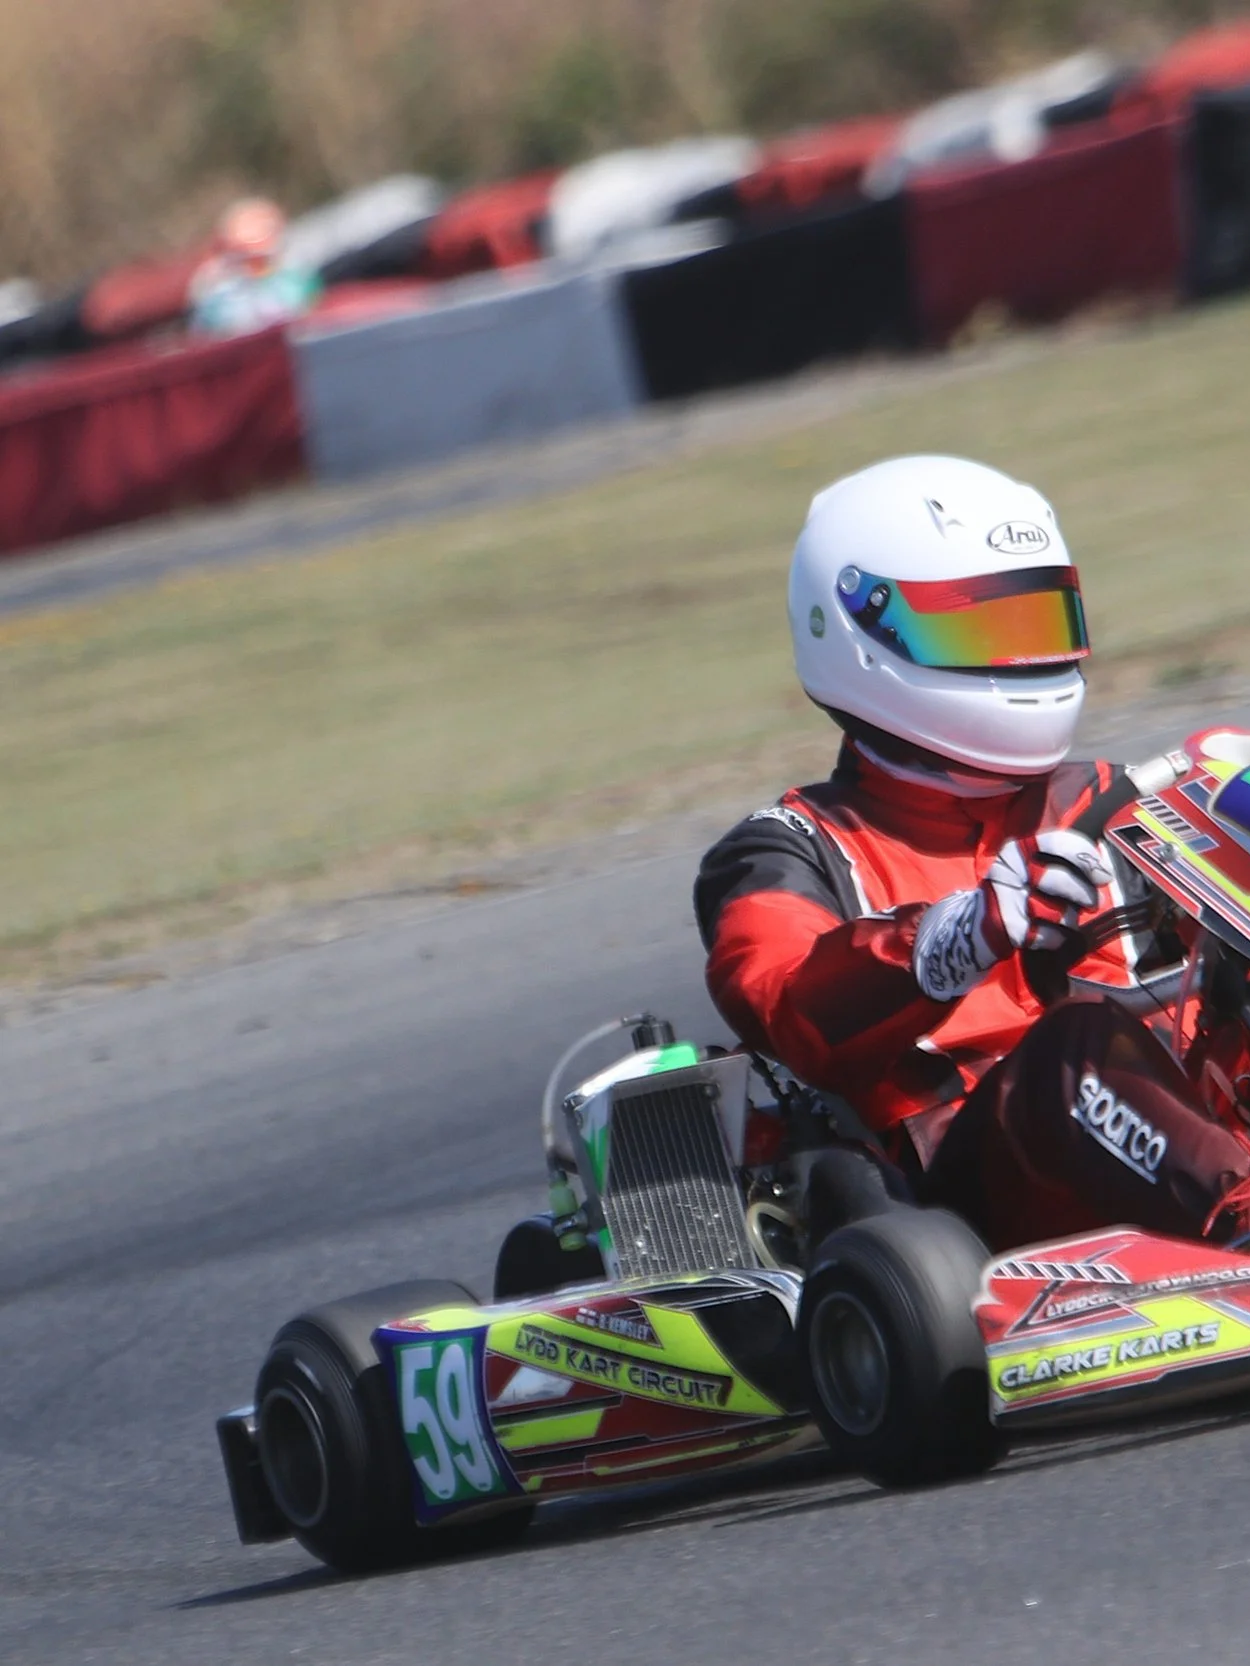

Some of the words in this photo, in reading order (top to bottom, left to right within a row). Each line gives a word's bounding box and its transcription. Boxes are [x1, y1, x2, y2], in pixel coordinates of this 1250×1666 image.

[994, 525, 1043, 548] Arai
[1078, 1076, 1167, 1172] sparco
[515, 1328, 559, 1363] LYDD
[565, 1346, 622, 1380] KART
[627, 1366, 718, 1403] CIRCUIT
[1000, 1345, 1112, 1388] CLARKE
[1118, 1322, 1220, 1361] KARTS
[401, 1343, 493, 1499] 59
